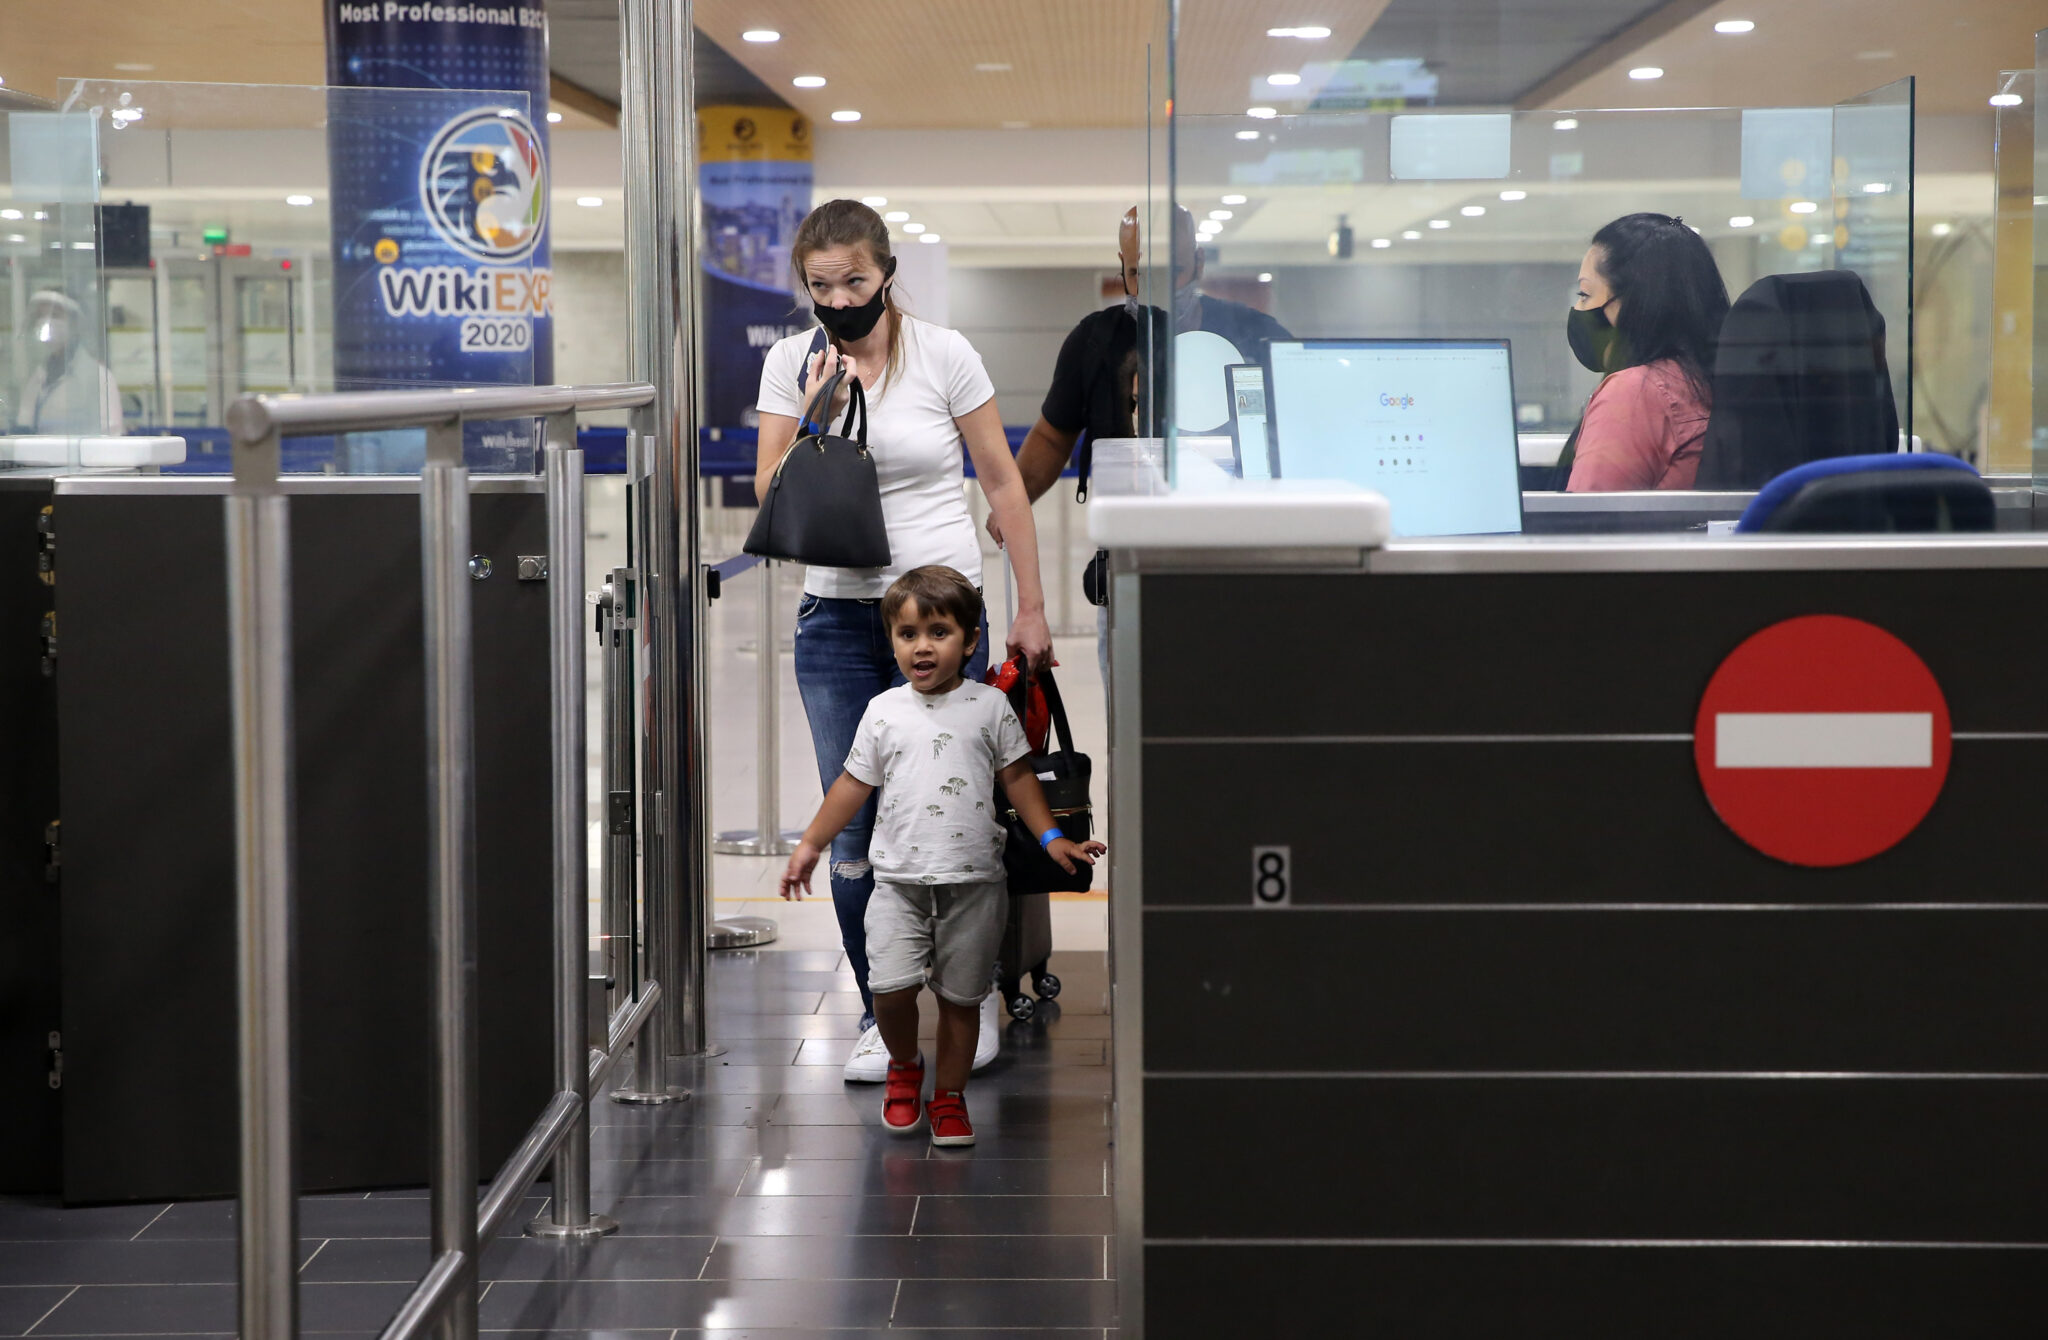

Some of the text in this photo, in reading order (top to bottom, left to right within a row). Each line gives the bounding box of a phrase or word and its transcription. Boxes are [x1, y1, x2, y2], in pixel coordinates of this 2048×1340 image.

[339, 4, 379, 23] Most
[383, 1, 516, 26] Professional
[381, 267, 552, 316] WikiEXP
[465, 321, 528, 348] 2020
[1380, 392, 1414, 410] Google
[1257, 851, 1286, 903] 8
